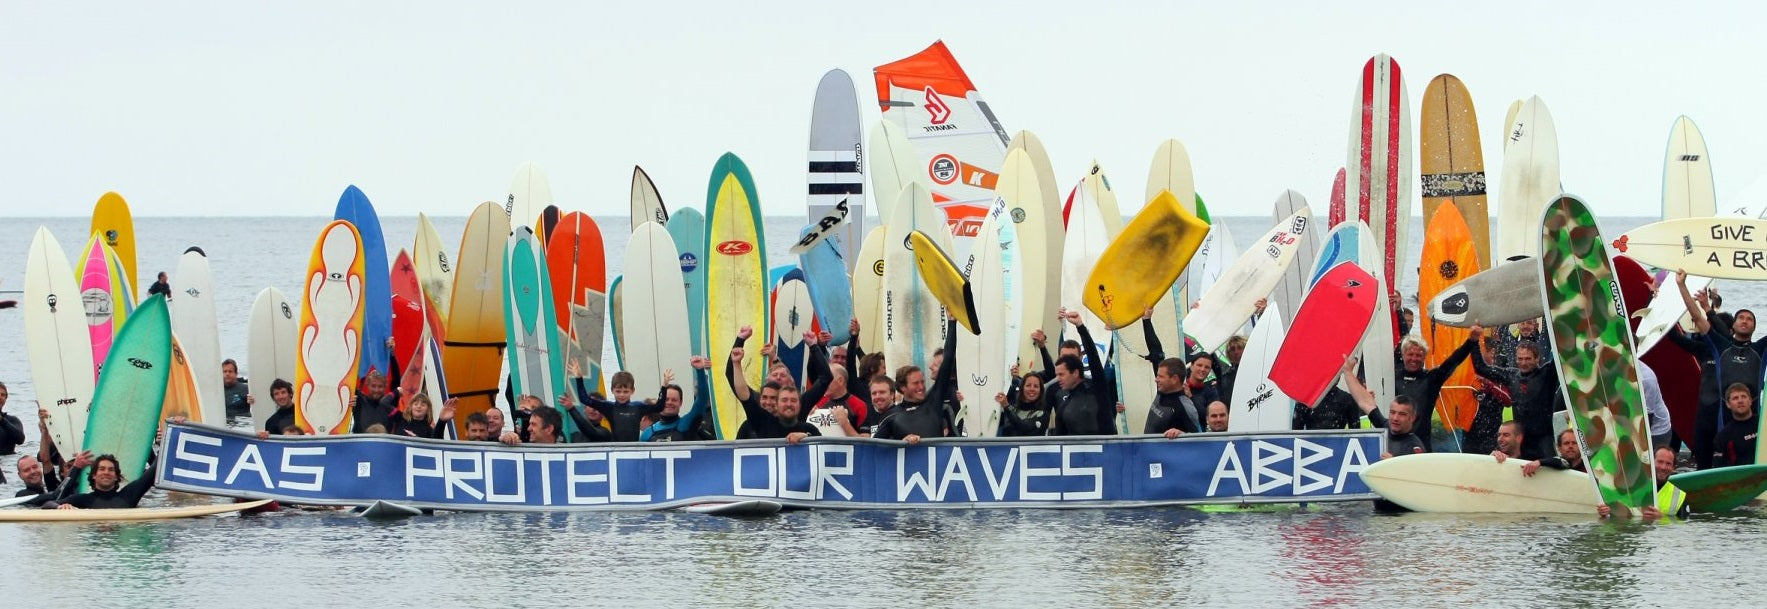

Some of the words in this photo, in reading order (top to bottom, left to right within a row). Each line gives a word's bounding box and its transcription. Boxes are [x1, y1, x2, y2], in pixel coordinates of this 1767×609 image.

[1710, 224, 1755, 242] GIVE
[1706, 252, 1721, 267] A
[1733, 250, 1767, 270] BR
[173, 432, 327, 492] SAS
[406, 447, 692, 506] PROTECT
[733, 445, 854, 501] OUR
[897, 445, 1103, 501] WAVES
[1206, 437, 1369, 497] ABBA
